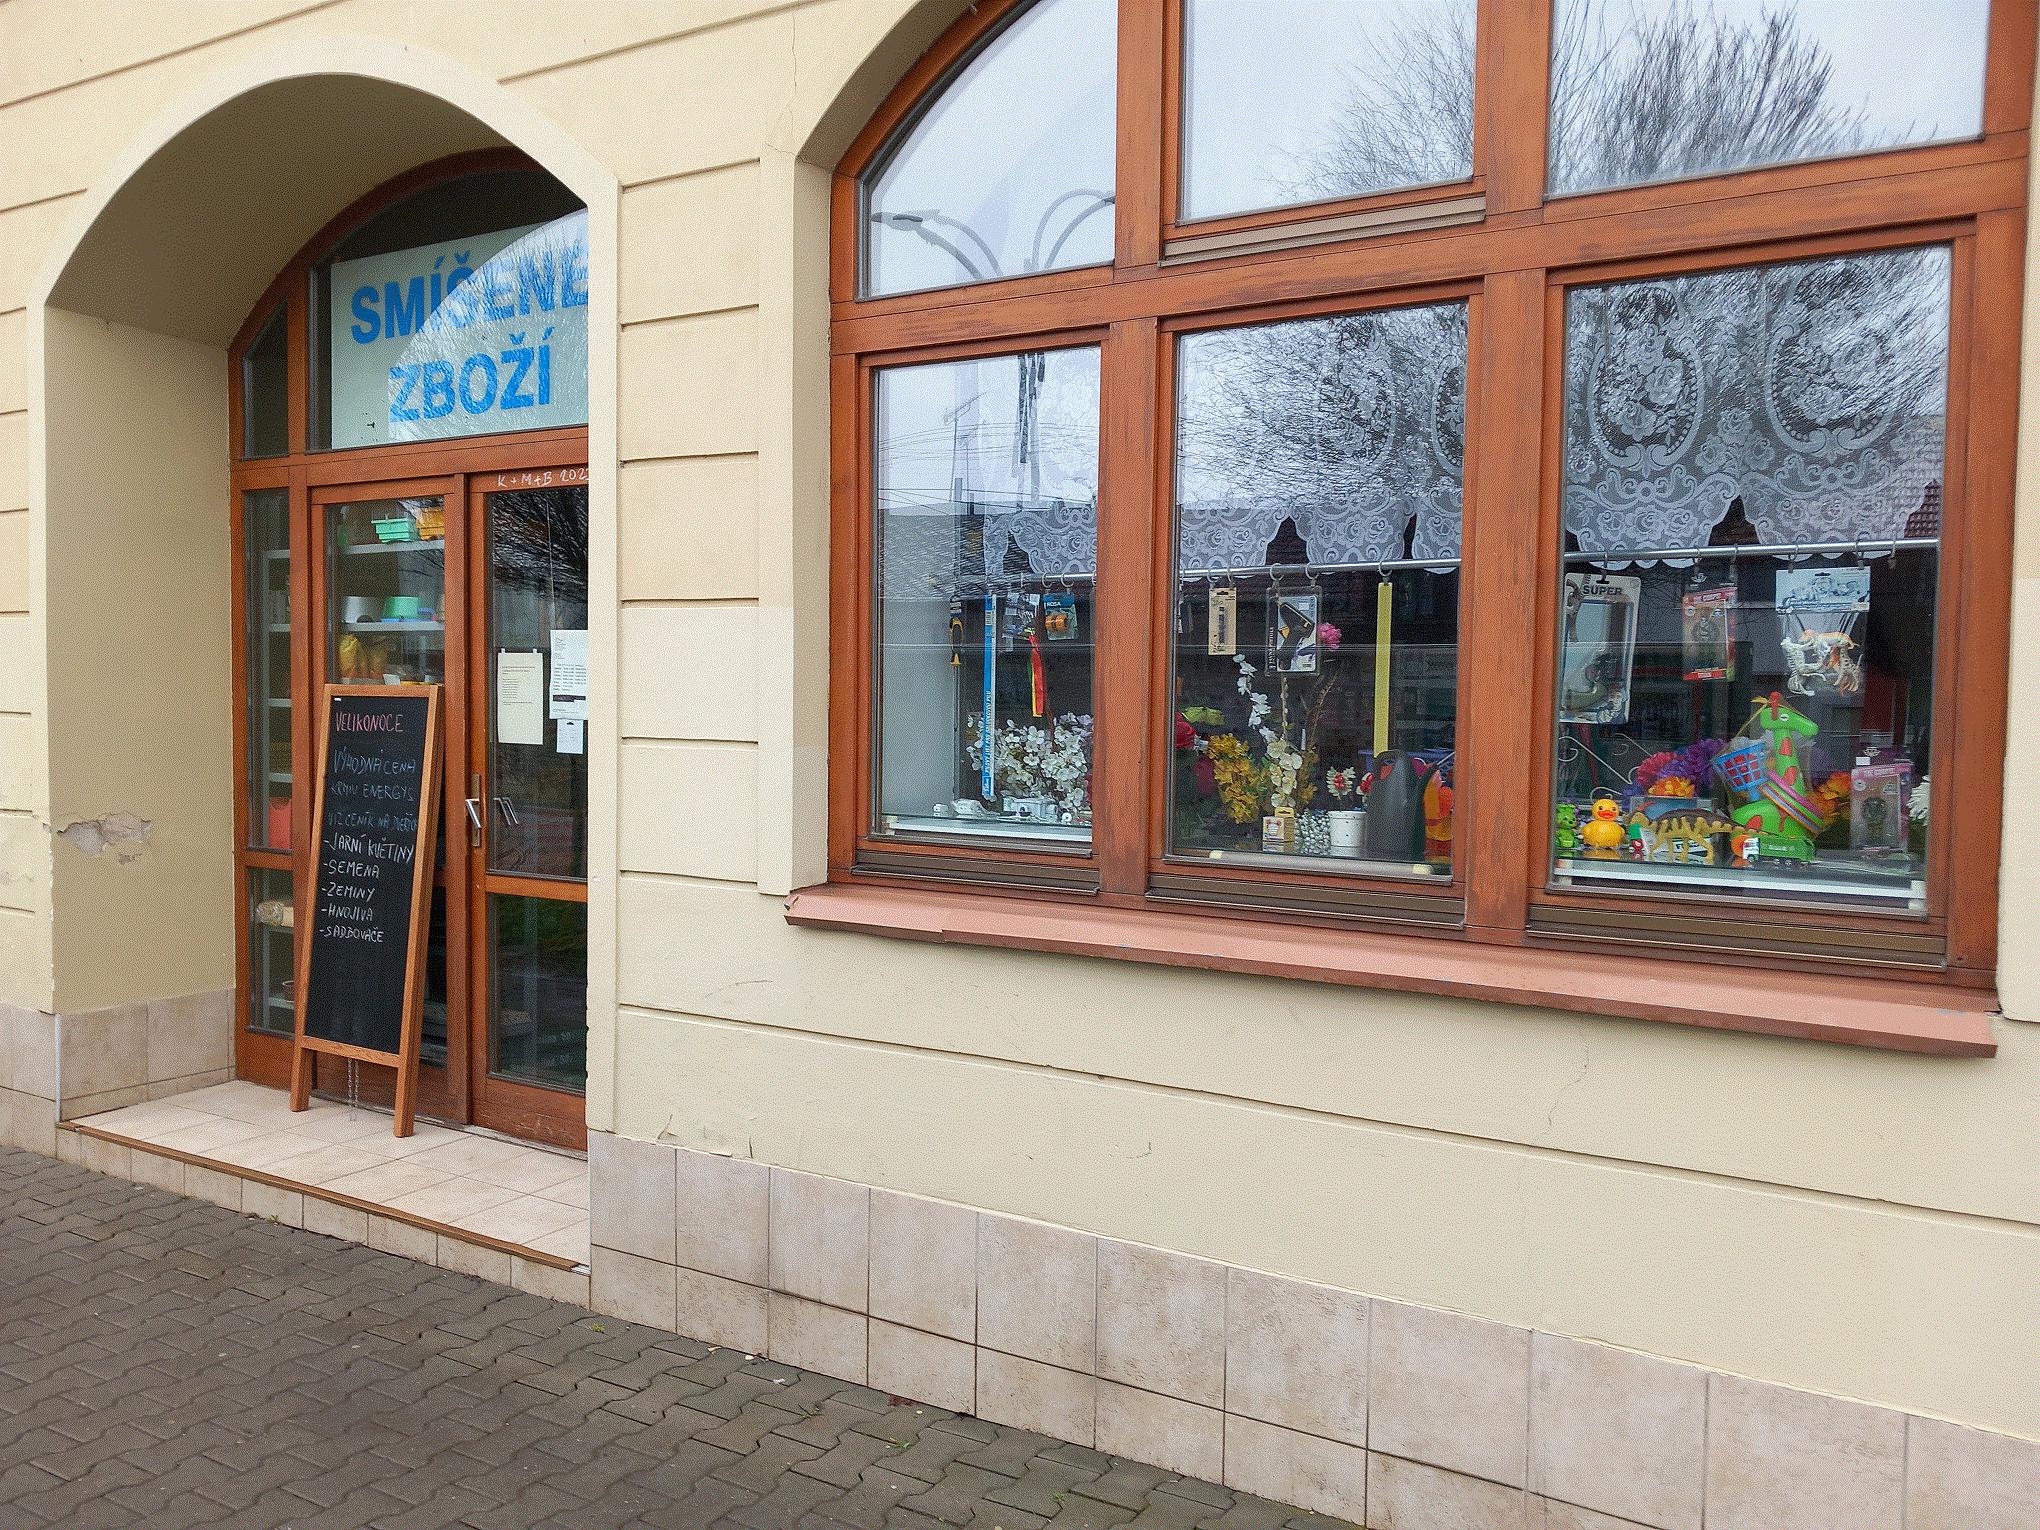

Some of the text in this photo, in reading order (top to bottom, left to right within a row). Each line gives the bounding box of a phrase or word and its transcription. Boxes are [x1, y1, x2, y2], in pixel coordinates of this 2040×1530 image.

[389, 326, 555, 422] ZBOŽÍ
[1583, 584, 1622, 596] SUPER
[336, 711, 404, 733] VELIKONOCE
[383, 759, 416, 775] CENA
[368, 837, 415, 863] KVĚTINY
